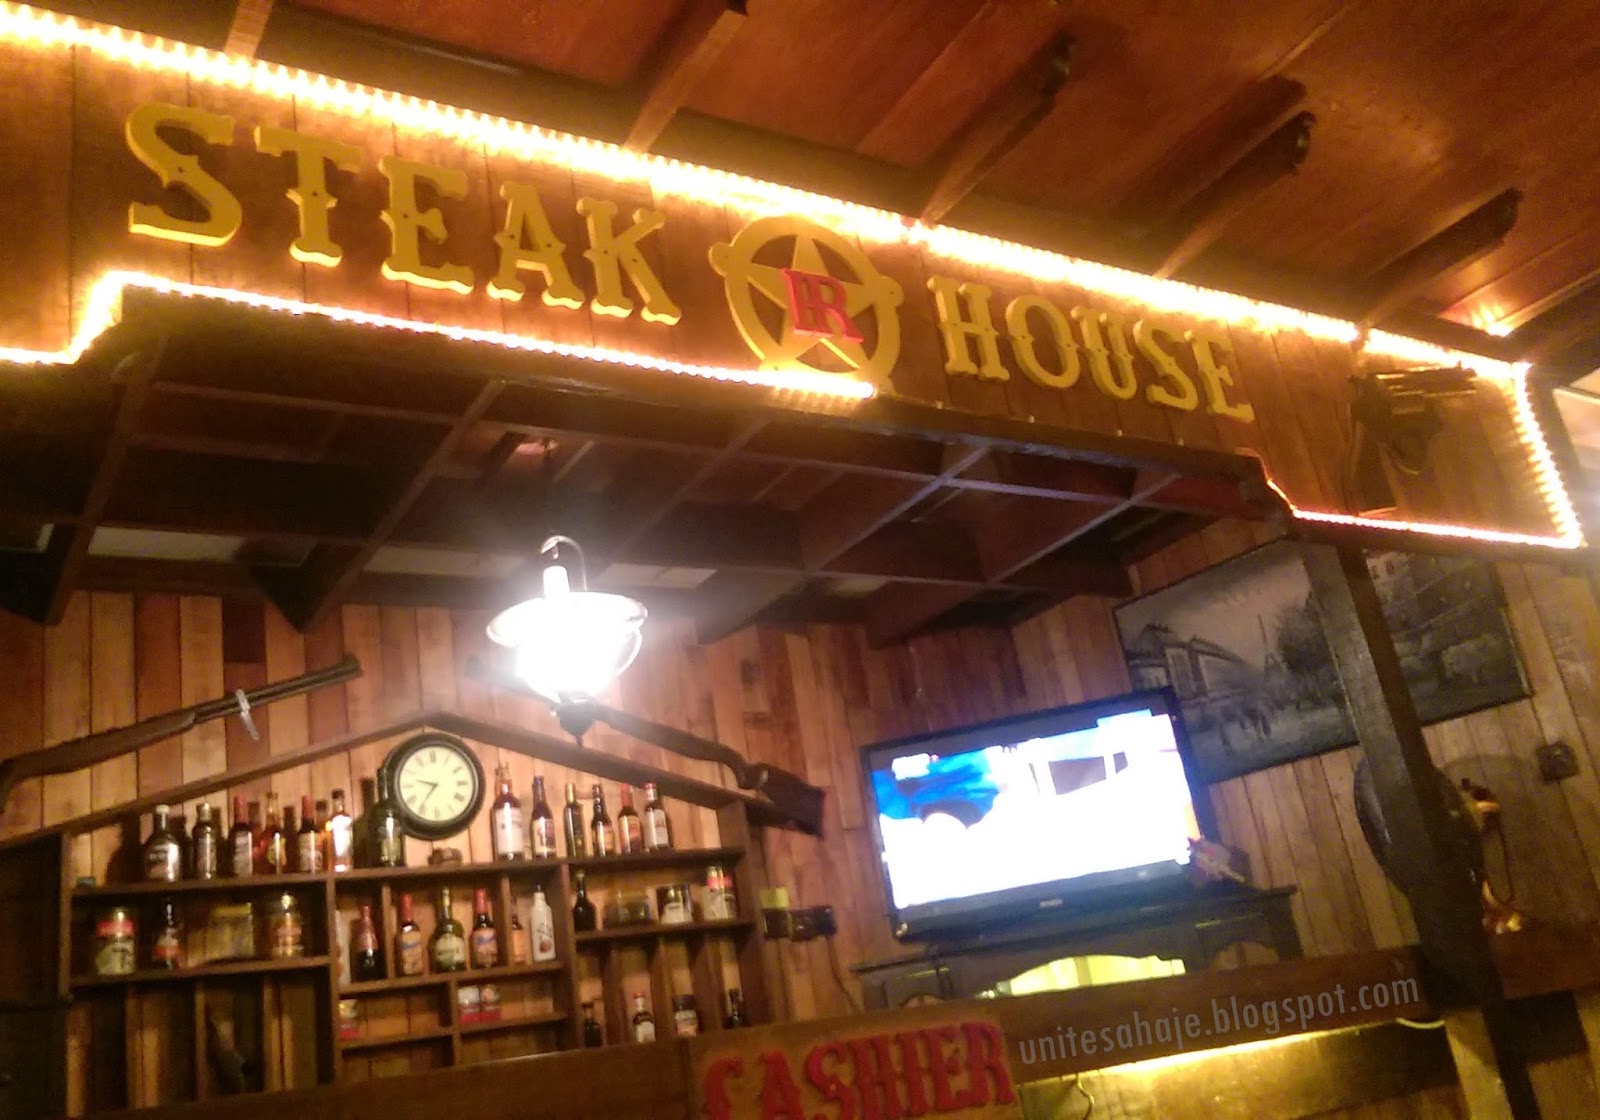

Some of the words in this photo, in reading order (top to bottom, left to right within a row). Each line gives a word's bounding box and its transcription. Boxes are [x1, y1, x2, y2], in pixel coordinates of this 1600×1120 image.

[125, 104, 682, 326] STEAK
[927, 275, 1255, 423] HOUSE
[702, 1020, 1015, 1120] CASHIER
